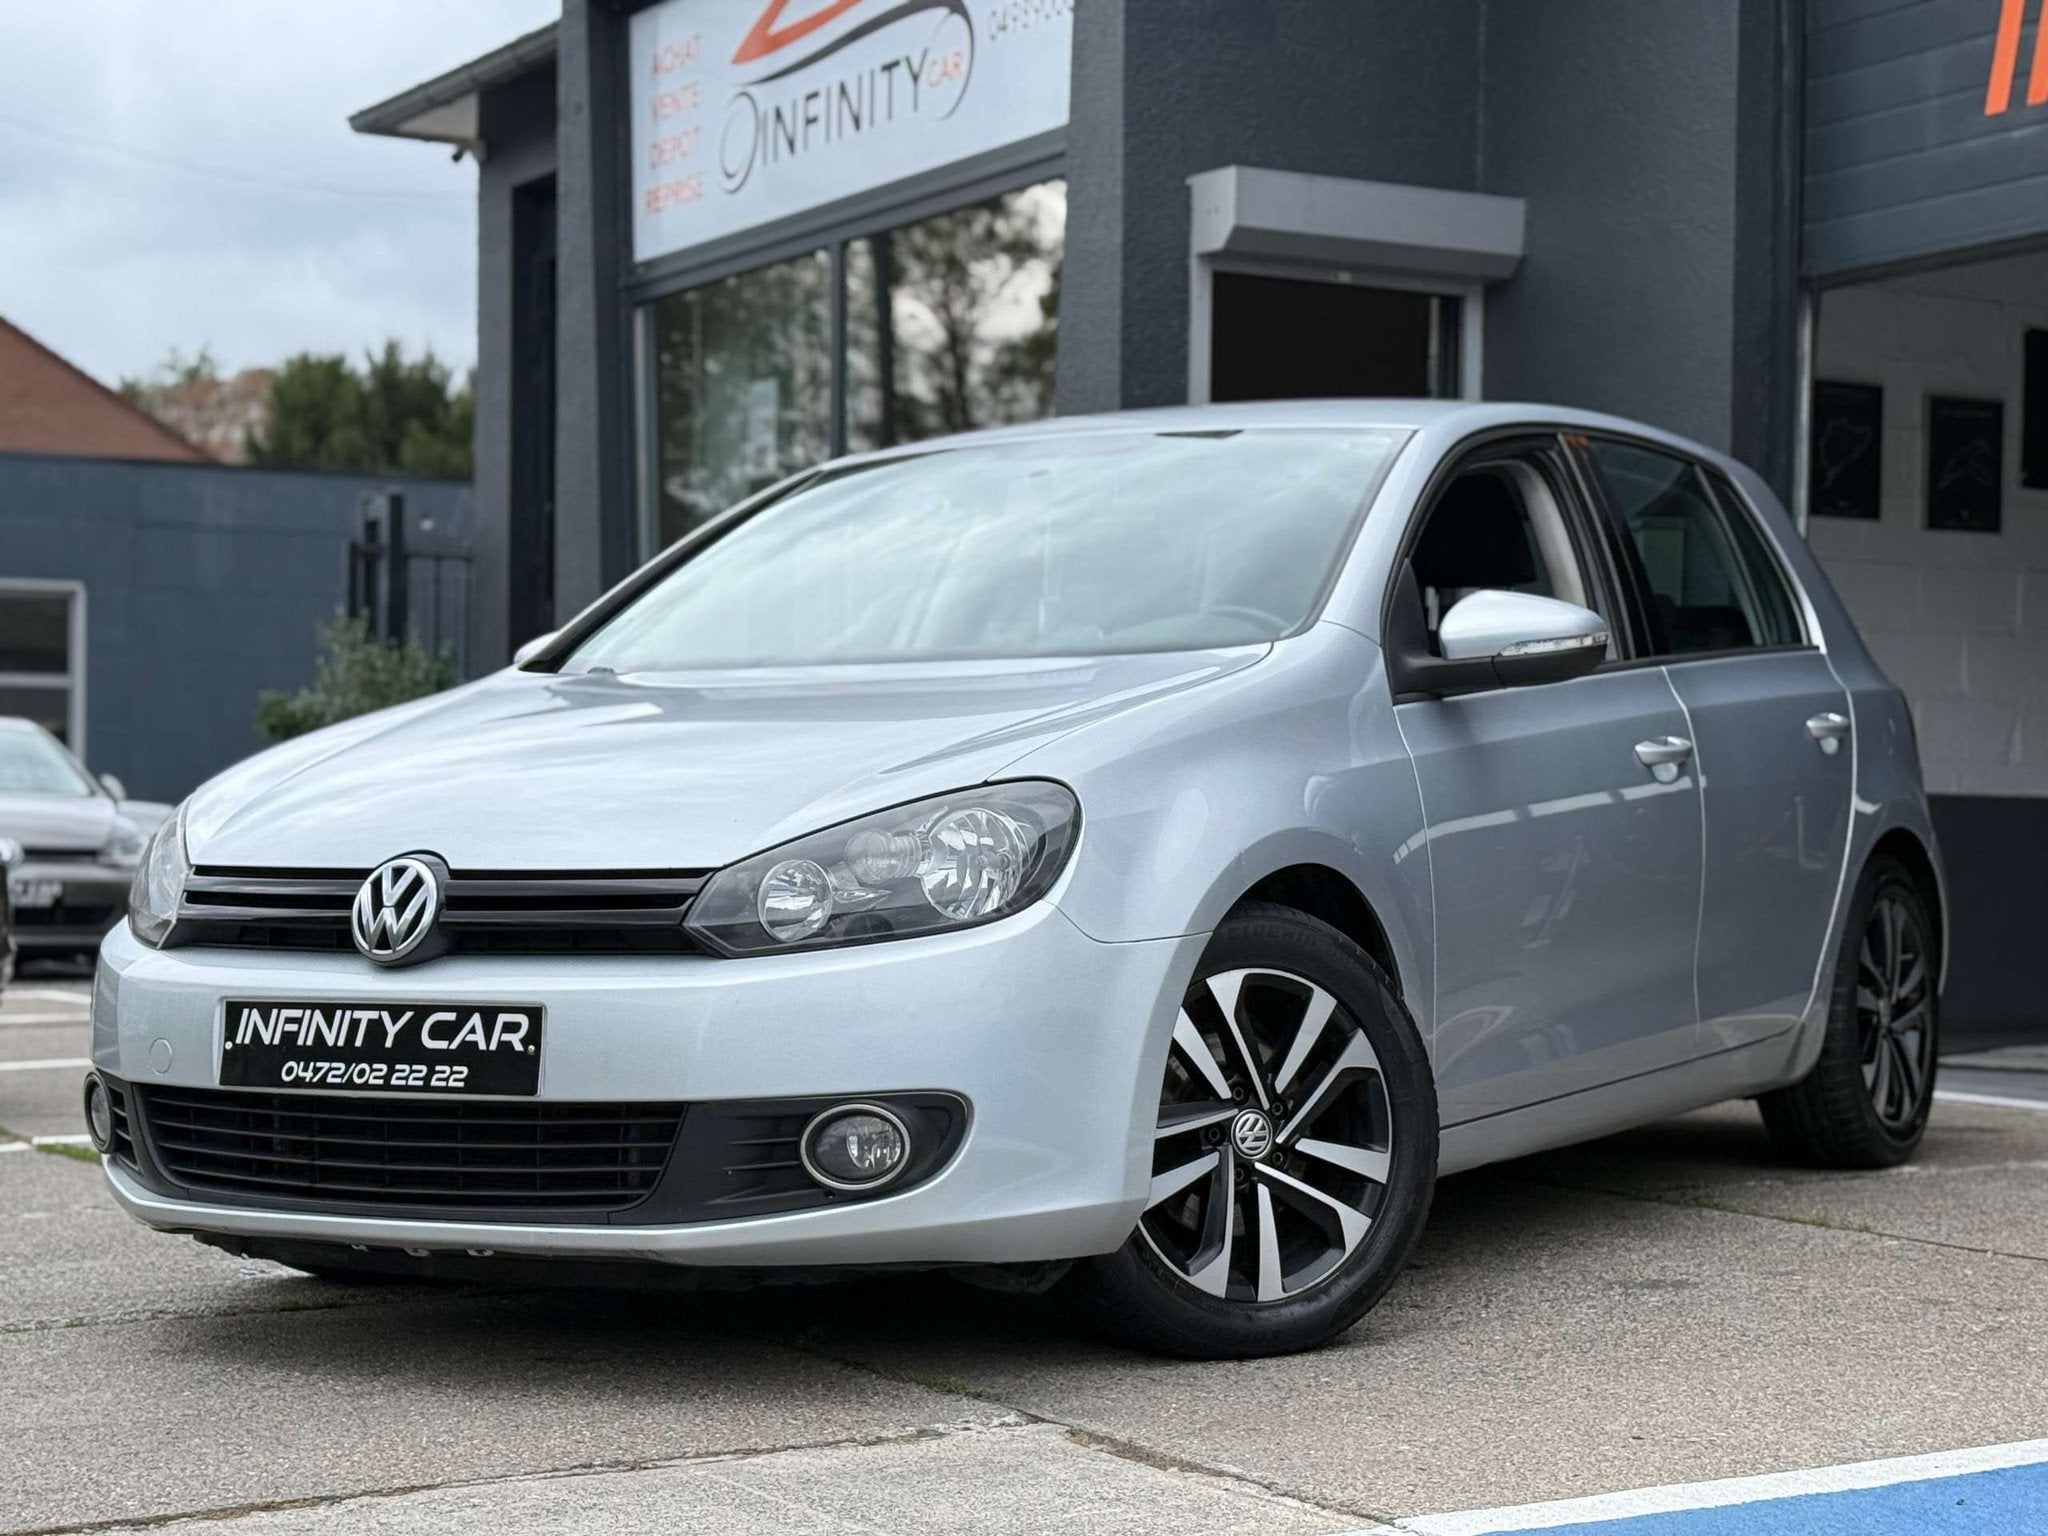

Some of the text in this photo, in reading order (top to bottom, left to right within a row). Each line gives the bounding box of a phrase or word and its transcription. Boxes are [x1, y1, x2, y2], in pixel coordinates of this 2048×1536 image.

[760, 46, 962, 167] INFINITY CAR
[235, 1008, 529, 1052] INFINITY CAR
[280, 1060, 469, 1088] 0472/02 22 22
